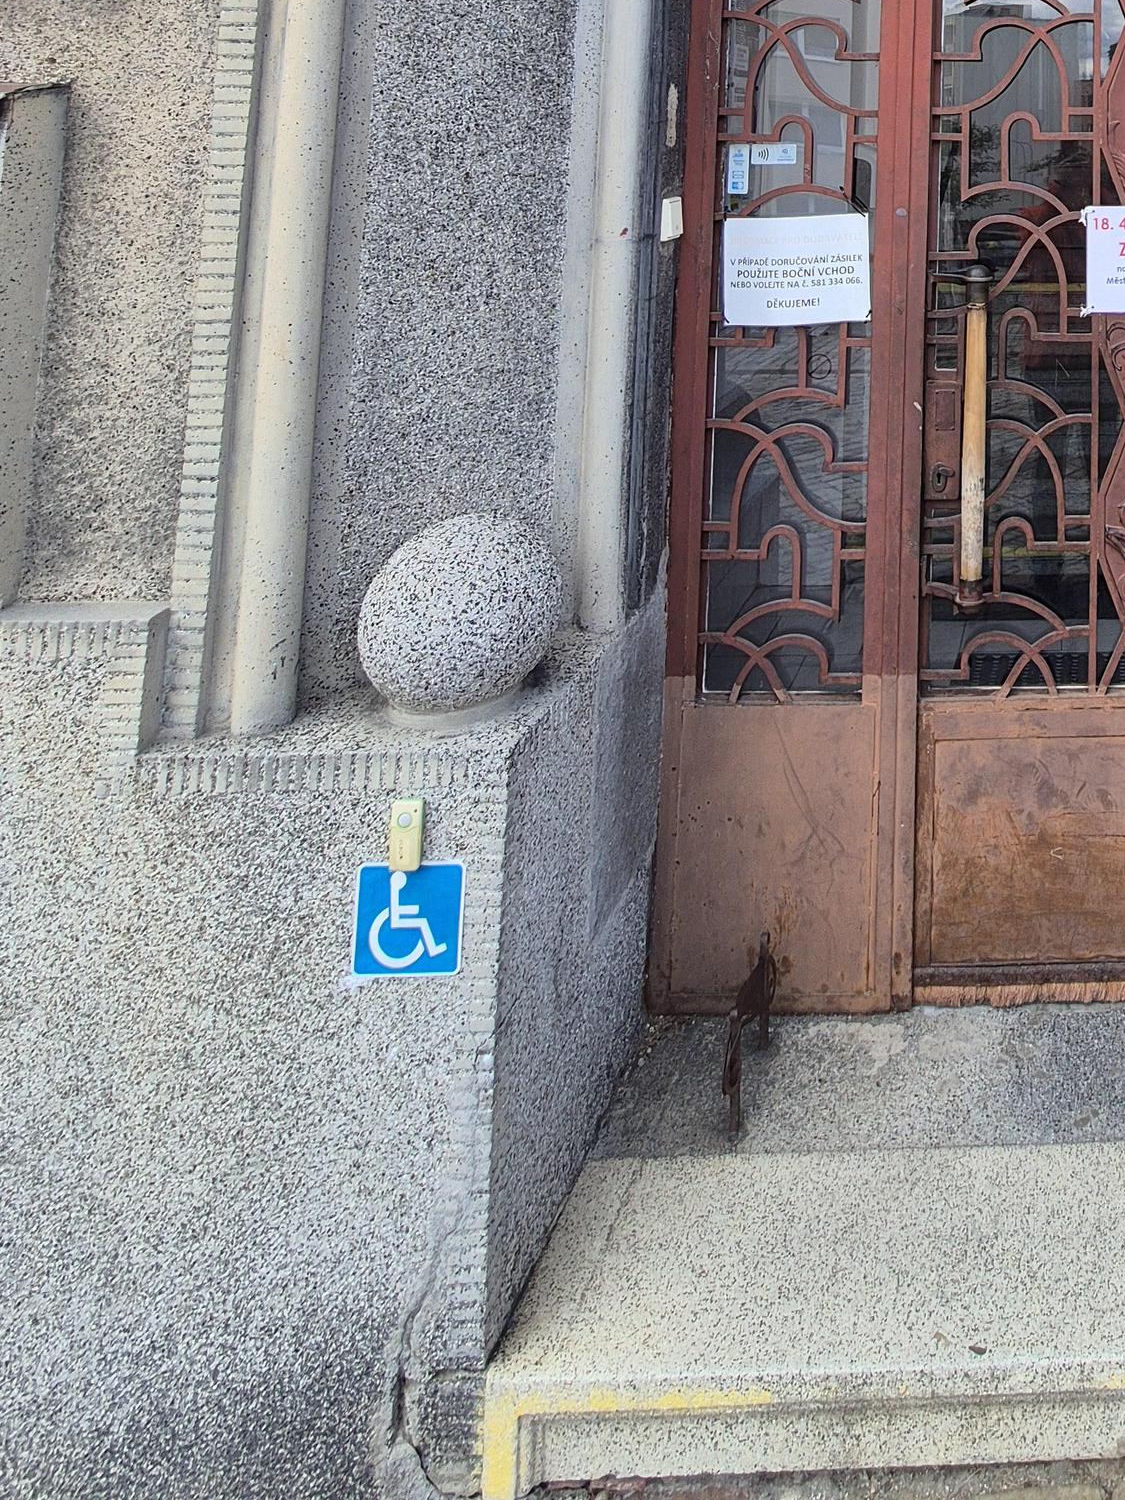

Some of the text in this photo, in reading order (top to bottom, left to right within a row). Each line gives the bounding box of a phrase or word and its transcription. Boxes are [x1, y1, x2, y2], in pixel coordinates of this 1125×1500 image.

[1093, 217, 1114, 230] 18.
[730, 258, 737, 266] V
[771, 254, 829, 266] DORUČOVÁNÍ
[830, 254, 863, 263] ZÁSILEK
[737, 265, 855, 279] POUŽIJTE BOČNÍ VCHOD
[730, 281, 751, 289] NEBO
[753, 281, 785, 289] VOLEJTE
[811, 279, 826, 287] 581
[828, 277, 843, 286] 334
[845, 276, 863, 285] 066.
[766, 297, 820, 309] DĚKUJEME!
